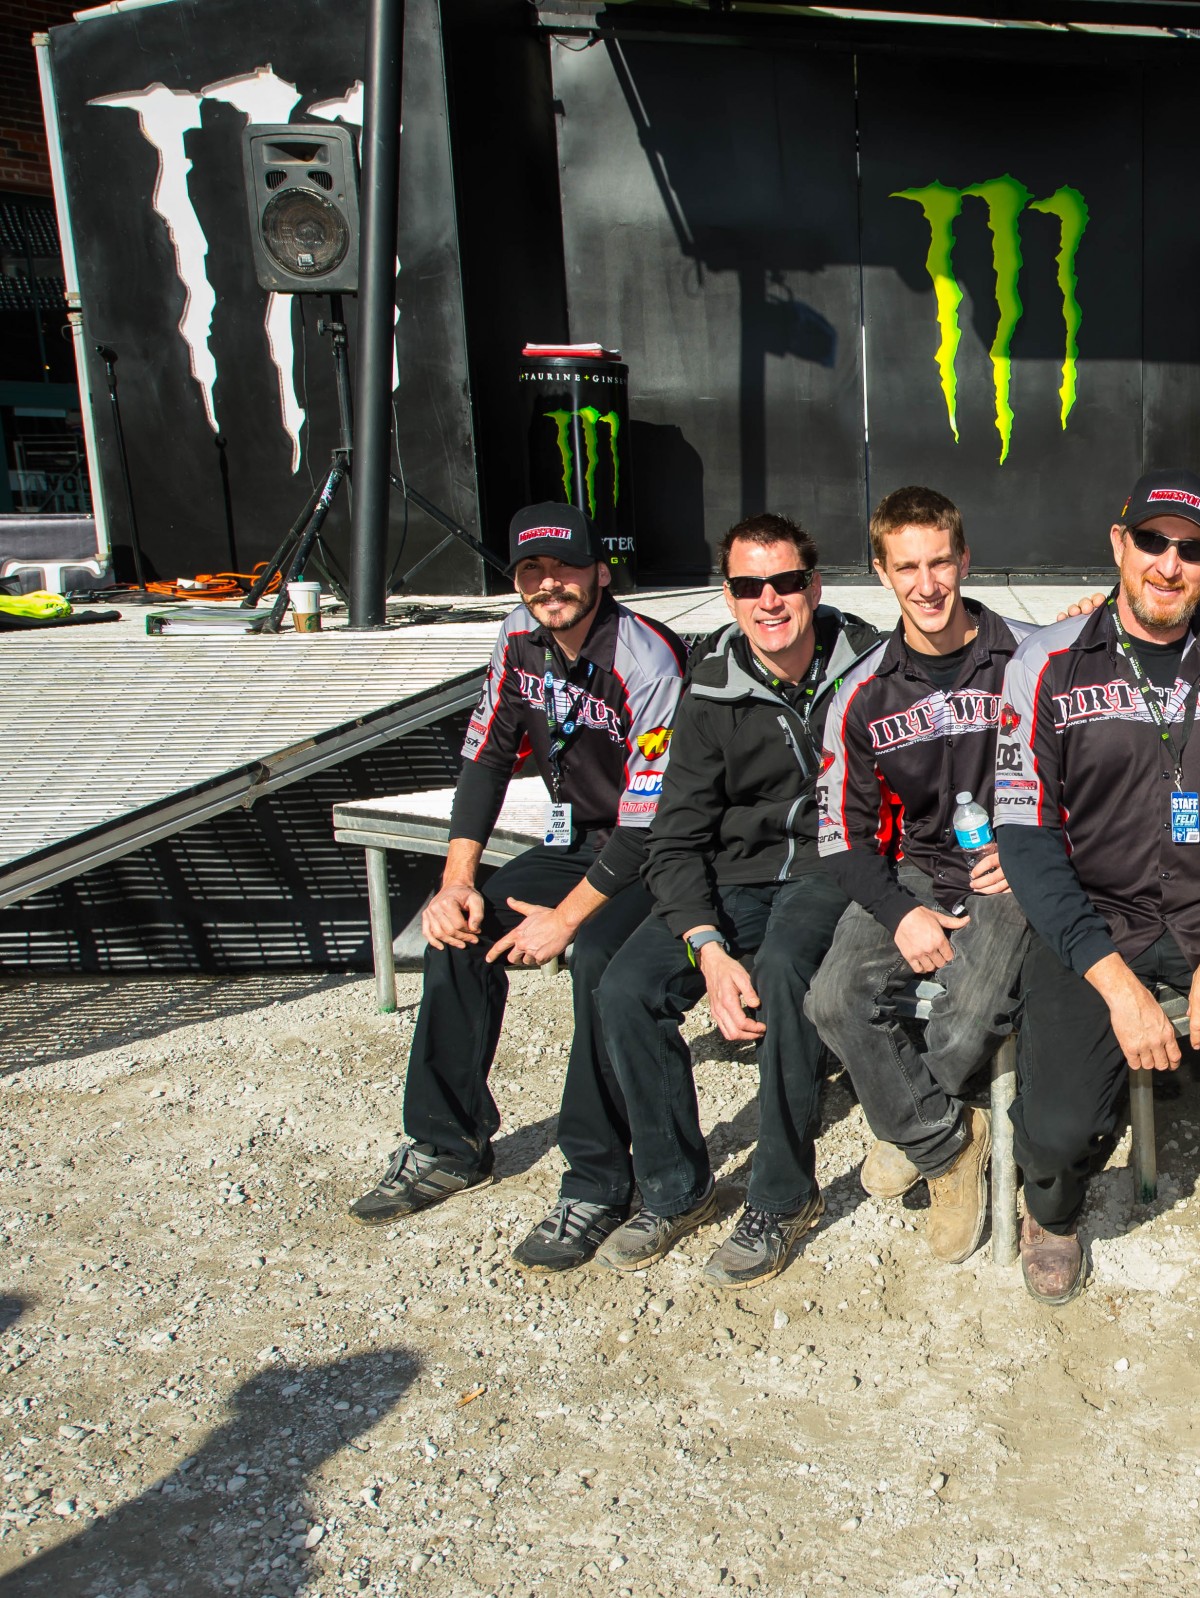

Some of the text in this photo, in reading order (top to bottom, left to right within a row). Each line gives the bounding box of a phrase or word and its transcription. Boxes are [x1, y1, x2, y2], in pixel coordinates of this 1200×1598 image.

[524, 372, 624, 385] TAURINE GINSE
[949, 694, 1001, 724] WU
[1172, 797, 1199, 810] STAFF
[1175, 814, 1197, 824] FELD
